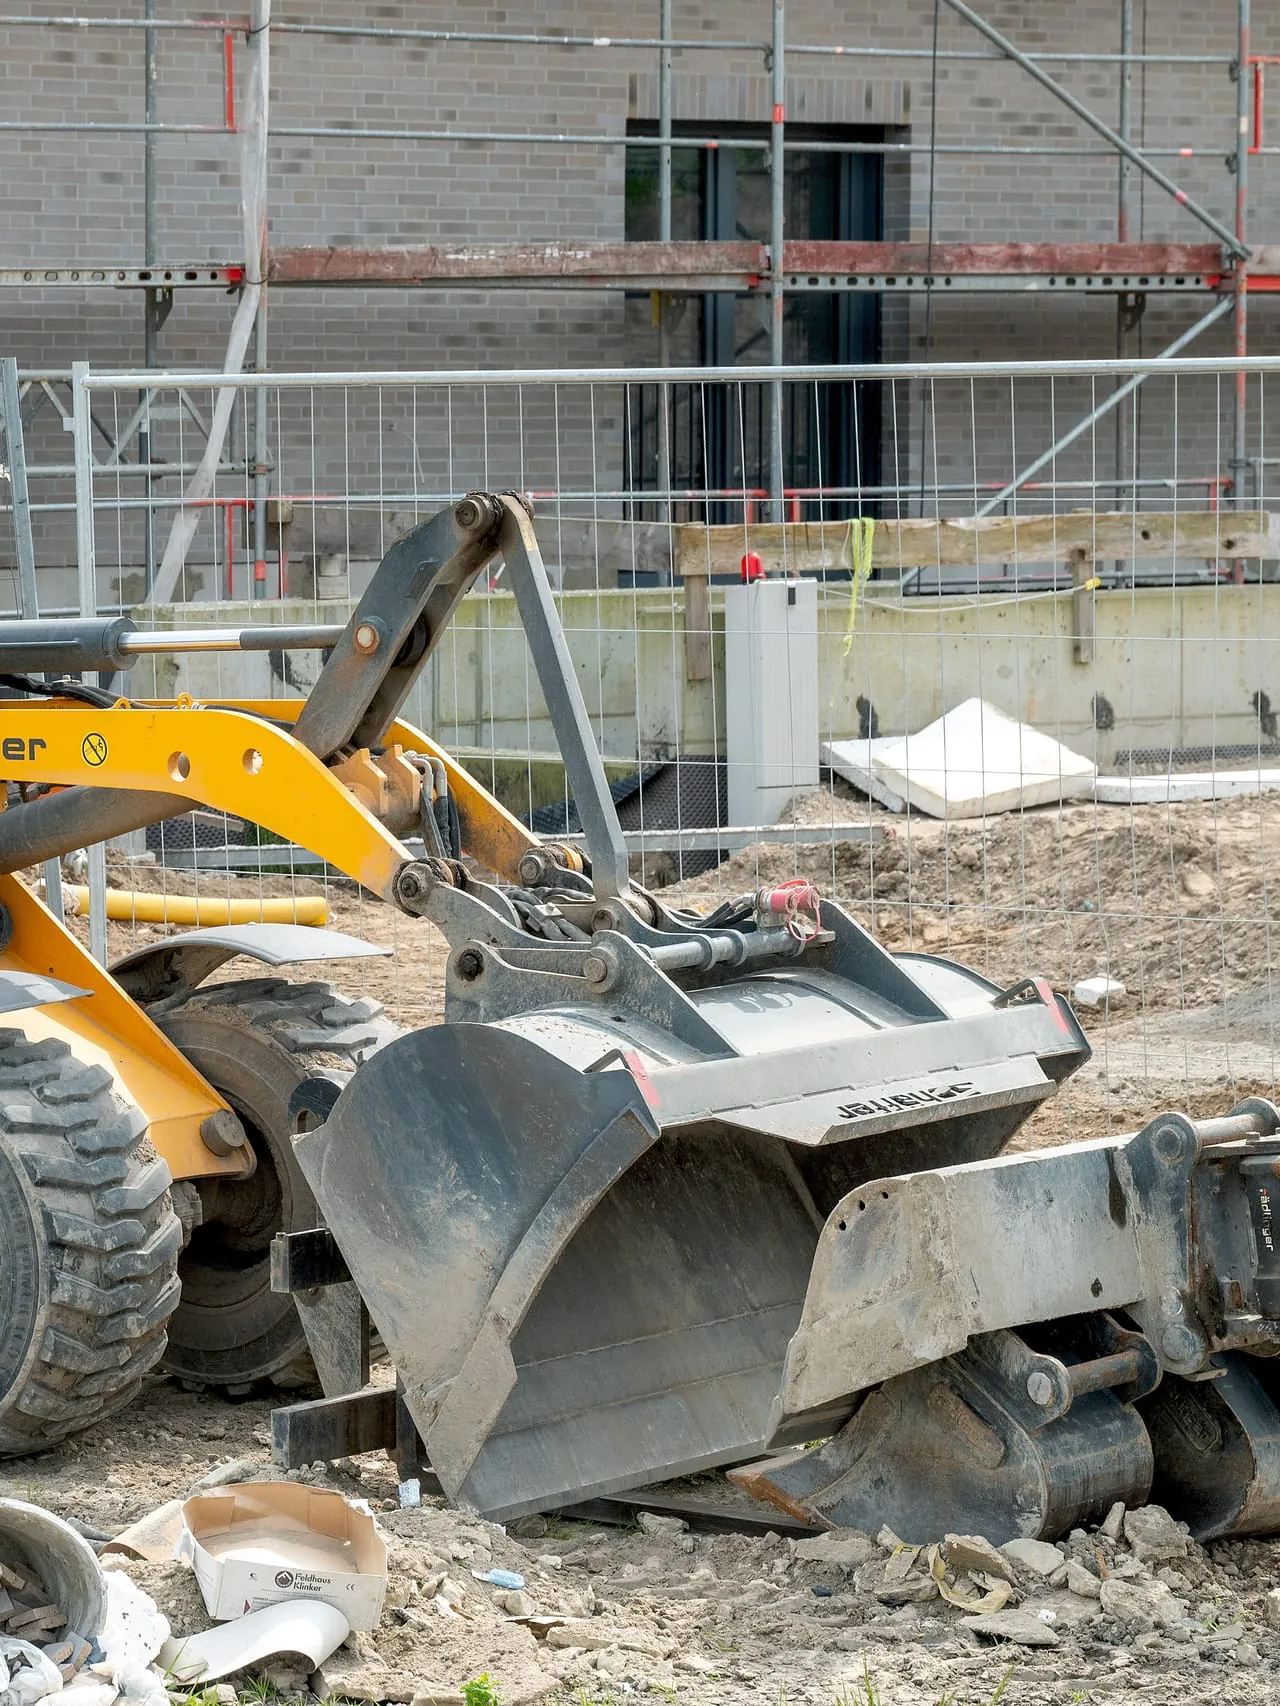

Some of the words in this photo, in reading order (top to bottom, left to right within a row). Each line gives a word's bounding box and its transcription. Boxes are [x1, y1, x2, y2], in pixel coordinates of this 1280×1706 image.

[1259, 1188, 1274, 1252] rädlinger
[294, 1572, 332, 1584] Feldhaus
[293, 1581, 322, 1592] Klinker
